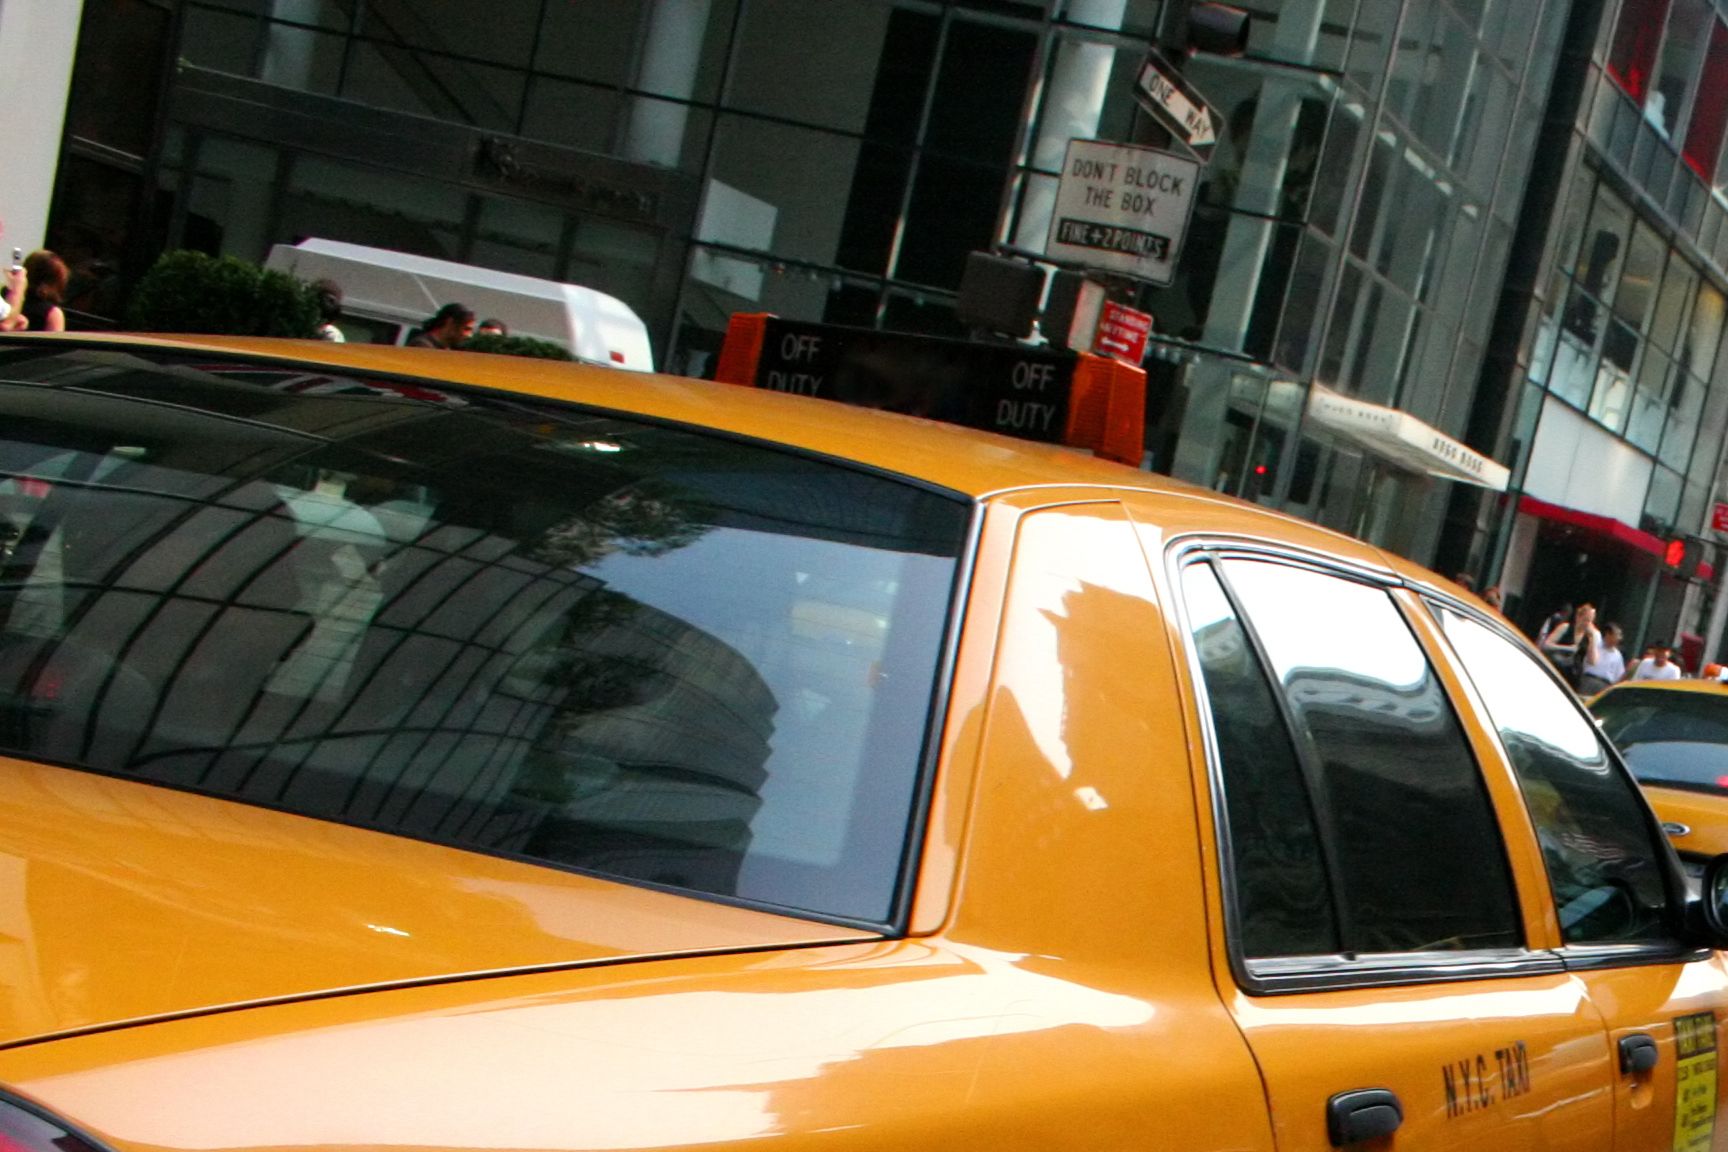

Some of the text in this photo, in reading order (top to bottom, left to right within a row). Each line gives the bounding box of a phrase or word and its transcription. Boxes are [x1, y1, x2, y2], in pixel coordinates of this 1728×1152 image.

[1149, 70, 1211, 138] ONE WAY
[1072, 157, 1184, 196] DON'T BLOCK
[1085, 186, 1155, 215] THE BOX
[1061, 222, 1089, 244] FINE
[781, 334, 820, 364] OFF
[1011, 361, 1055, 391] OFF
[996, 399, 1055, 431] DUTY
[1495, 1040, 1531, 1100] TAXI
